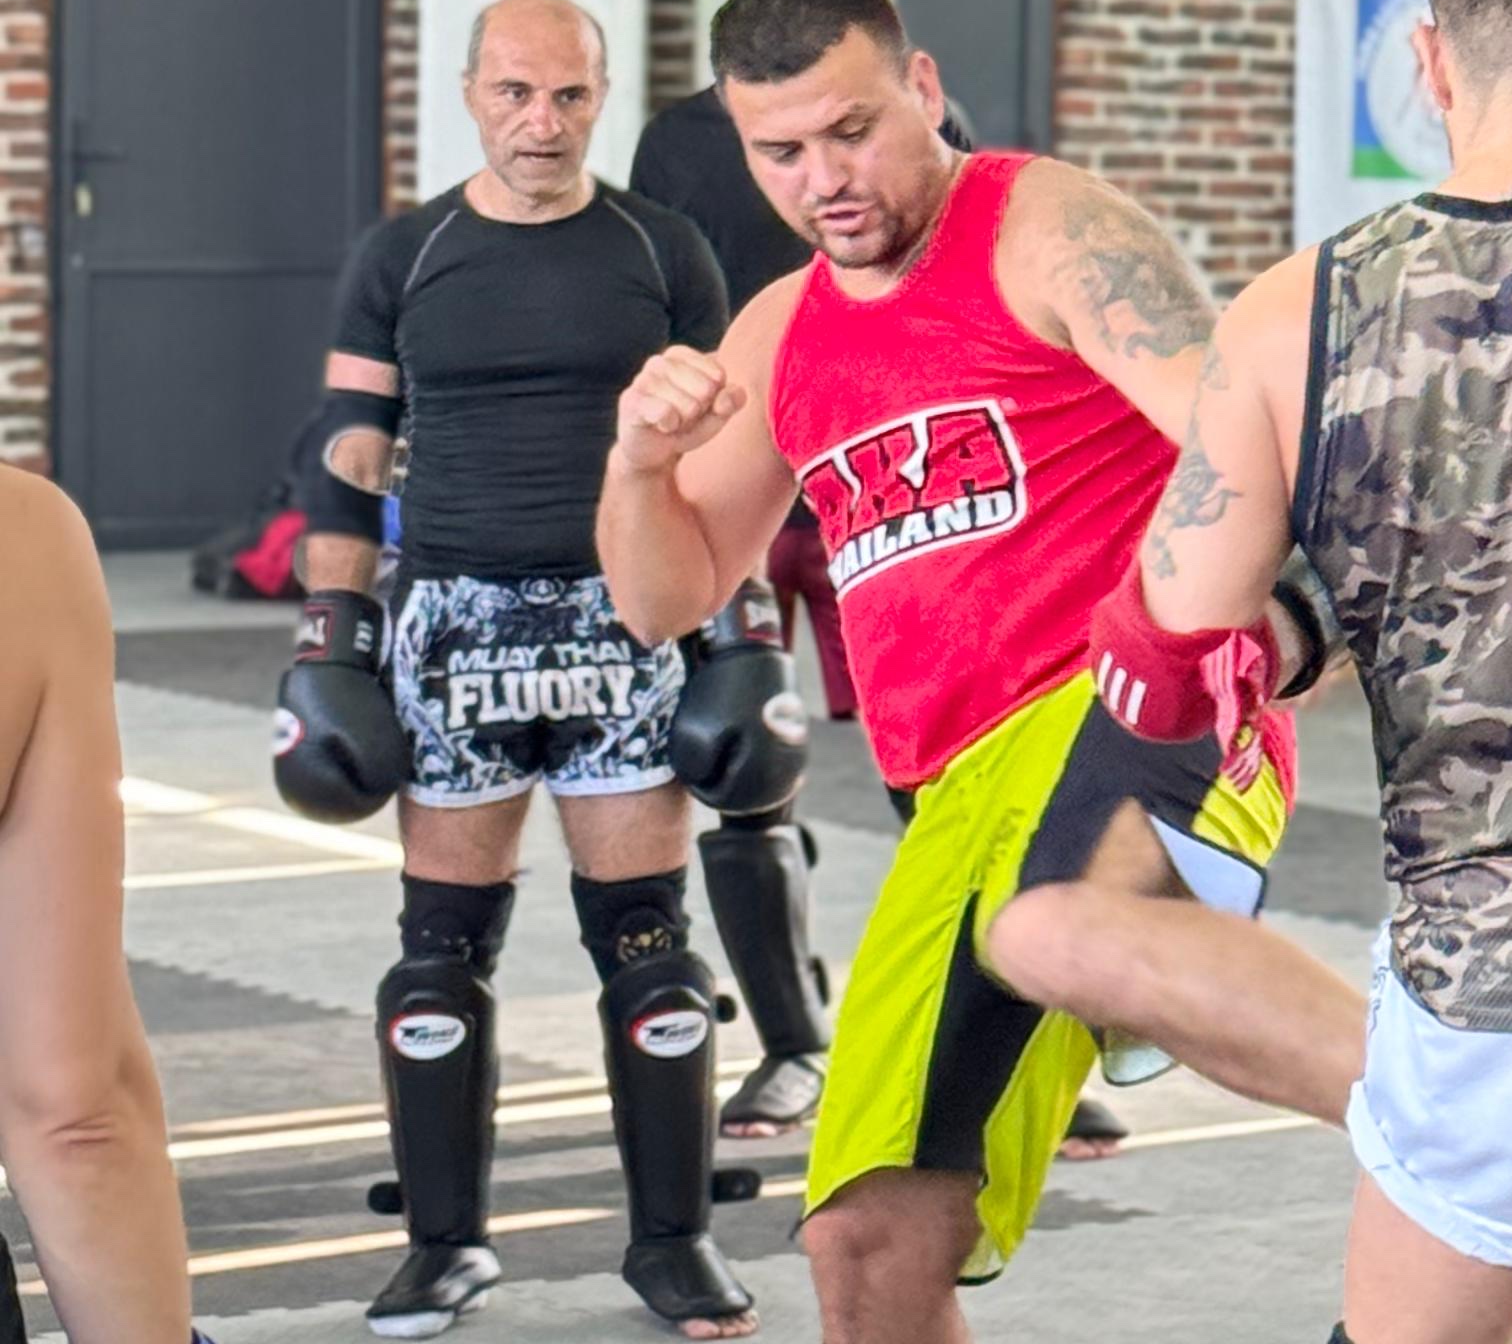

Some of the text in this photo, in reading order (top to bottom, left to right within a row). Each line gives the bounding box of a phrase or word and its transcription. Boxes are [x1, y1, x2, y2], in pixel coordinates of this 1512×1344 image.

[448, 639, 633, 674] MUAY THAI
[447, 664, 635, 730] FLUORY
